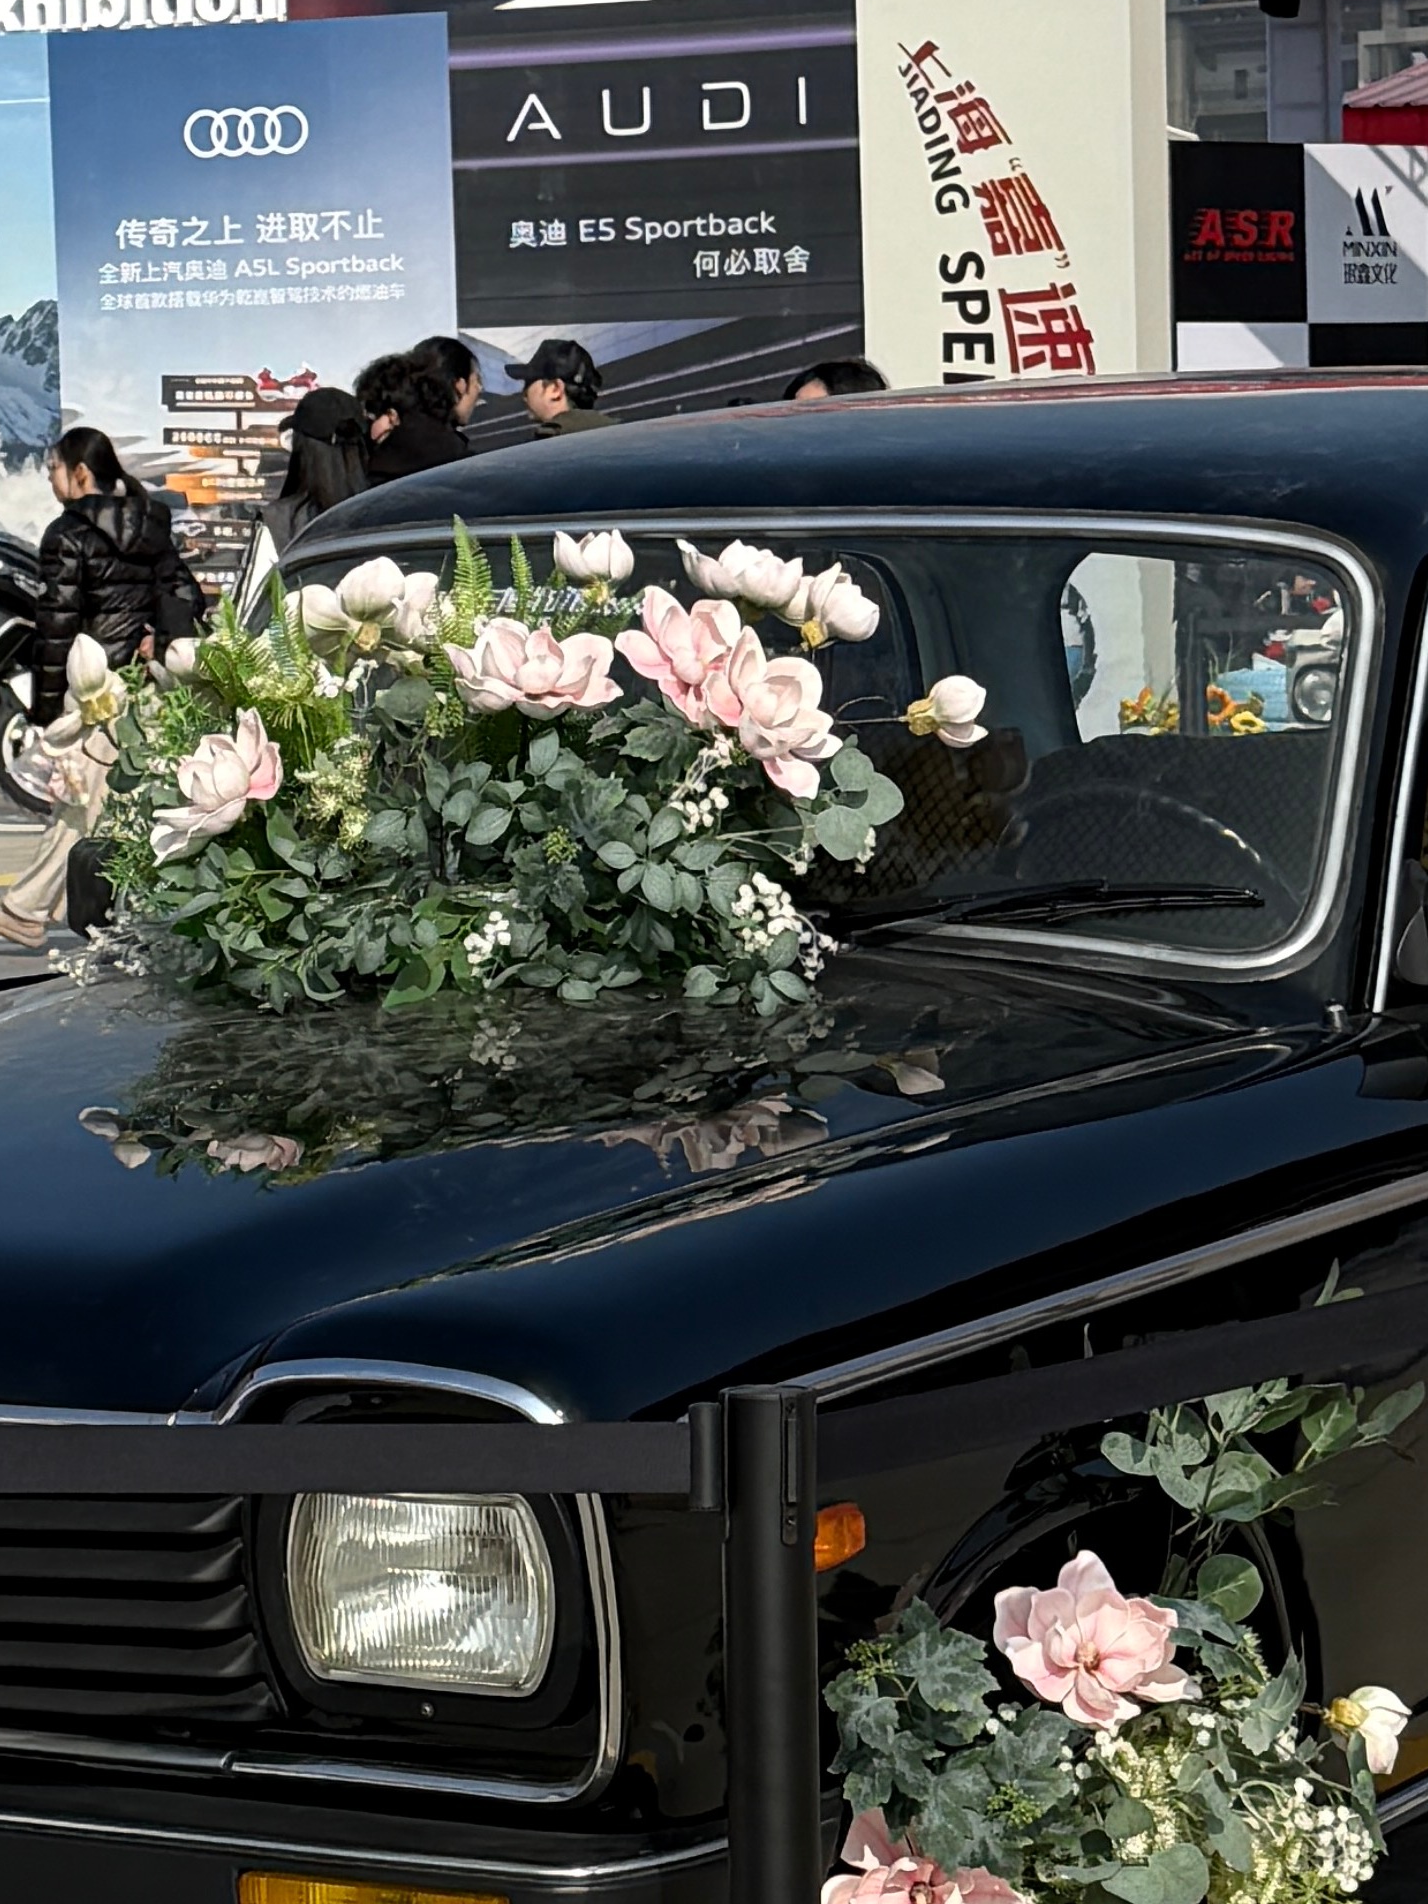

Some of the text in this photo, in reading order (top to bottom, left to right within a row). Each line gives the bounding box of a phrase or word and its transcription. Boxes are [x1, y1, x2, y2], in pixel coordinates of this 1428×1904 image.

[506, 76, 808, 141] AUDI
[115, 208, 385, 250] 传奇之上 进取不止
[509, 210, 778, 248] 奥迪 E5 Sportback
[897, 62, 996, 385] JIADING SPE
[1191, 207, 1295, 248] ASR
[98, 253, 405, 285] 全新上汽奥迪 A5L Sportback
[692, 245, 811, 278] 何必取舍
